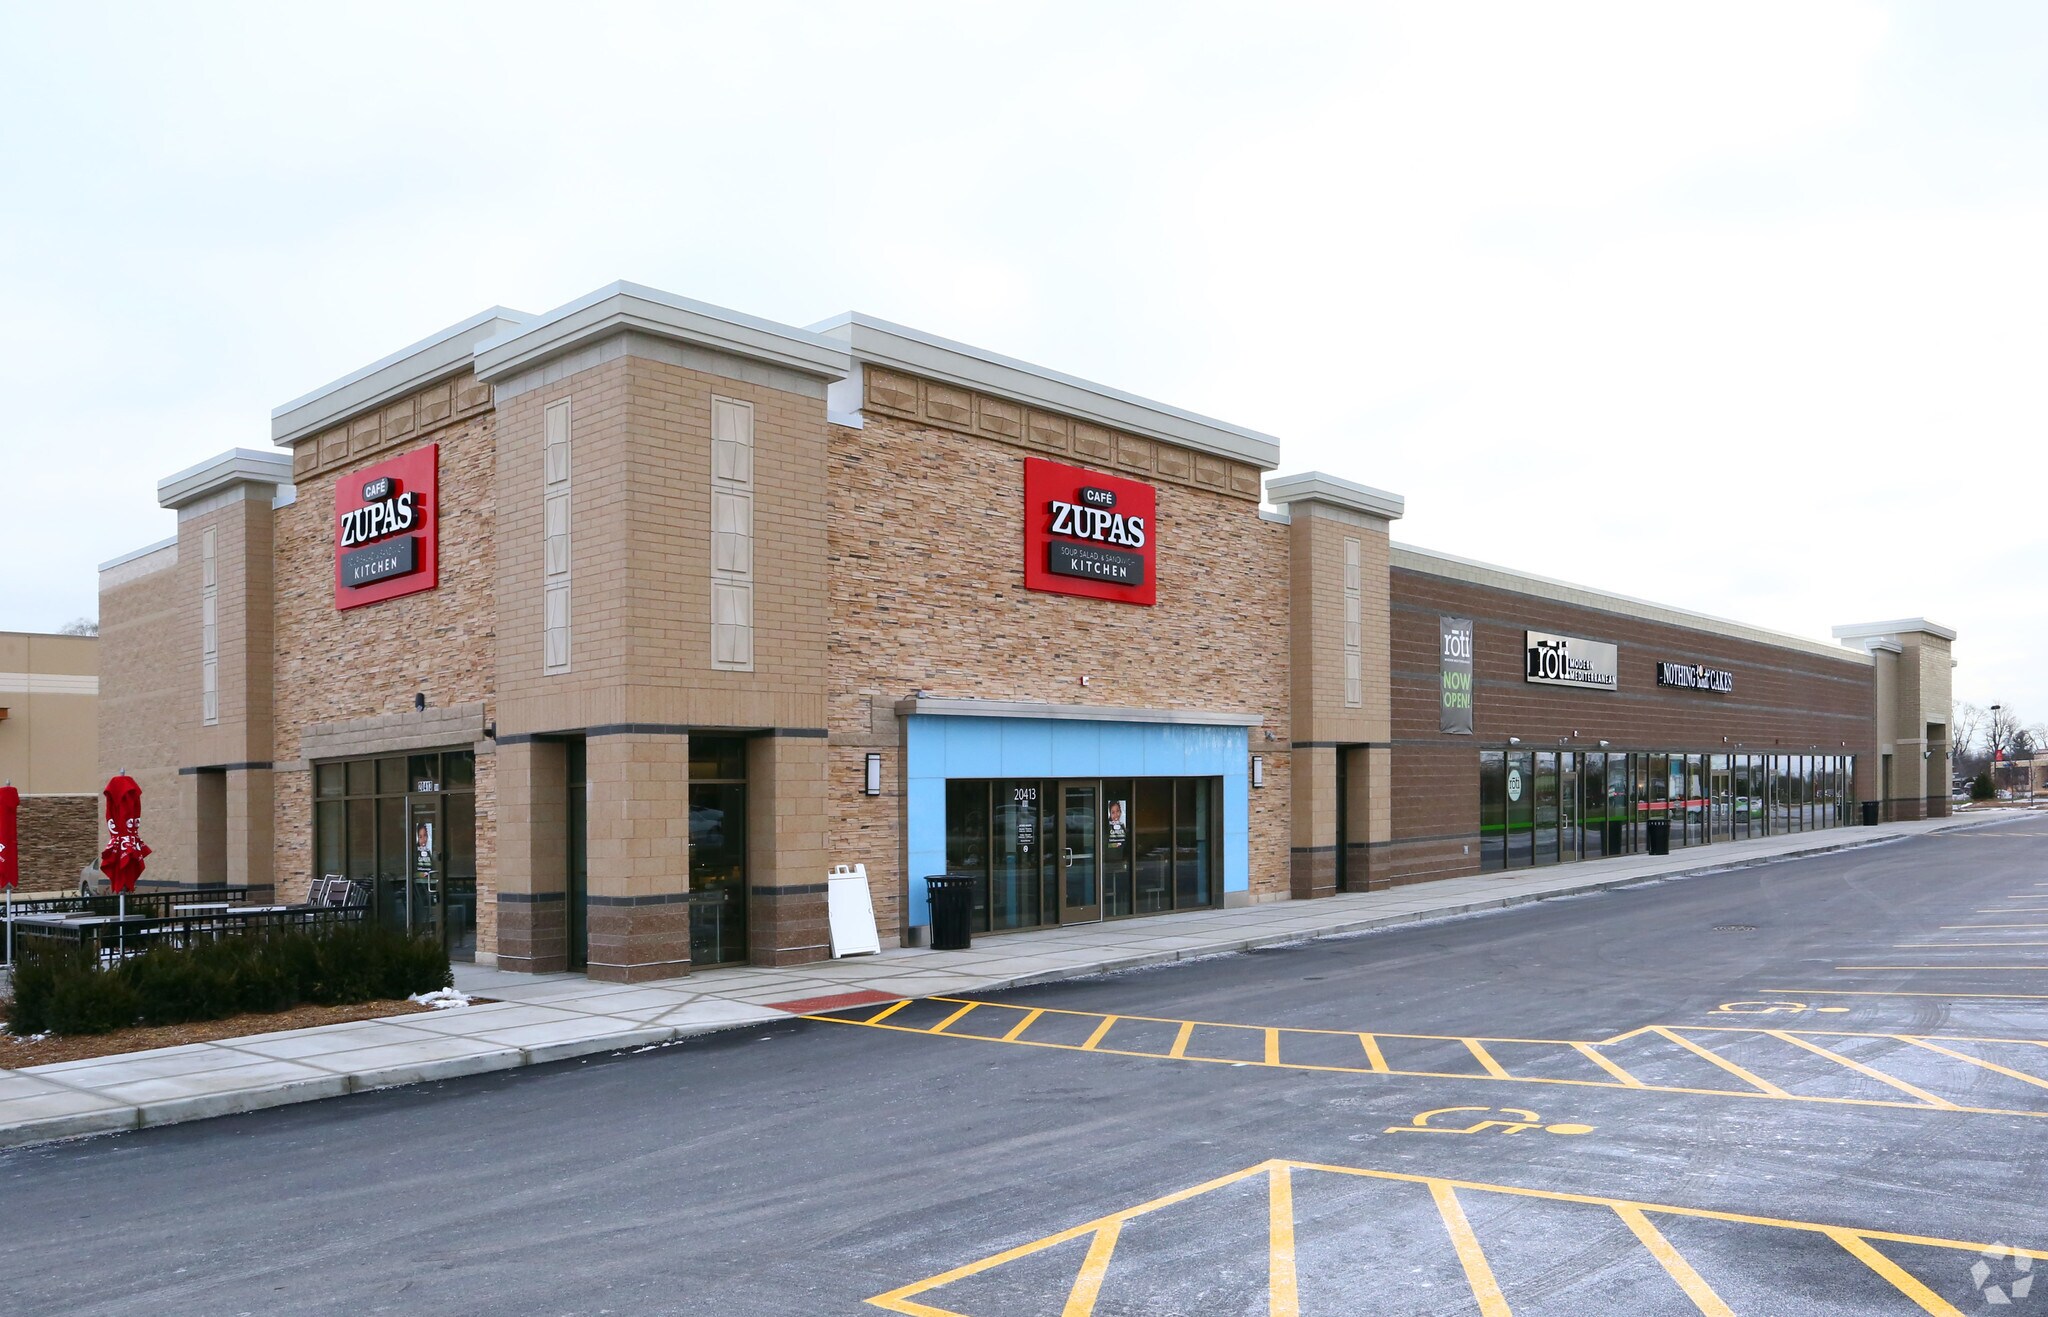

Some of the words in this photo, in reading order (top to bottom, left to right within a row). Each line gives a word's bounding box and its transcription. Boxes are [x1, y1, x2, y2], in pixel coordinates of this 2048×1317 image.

[365, 479, 386, 498] CAFÉ
[1086, 489, 1113, 505] CAFÉ
[340, 491, 412, 547] ZUPAS
[1052, 500, 1145, 548] ZUPAS
[354, 556, 397, 579] KITCHEN
[1071, 558, 1127, 578] KITCHEN
[1105, 554, 1136, 566] SANDWC
[1569, 658, 1595, 670] MODERN
[1443, 671, 1471, 691] NOW
[1569, 670, 1617, 685] MEDITERRANEAN
[1663, 662, 1696, 687] NOTHING
[1710, 669, 1733, 692] CAKES
[1444, 692, 1471, 709] OPEN!
[1014, 788, 1037, 801] 20413
